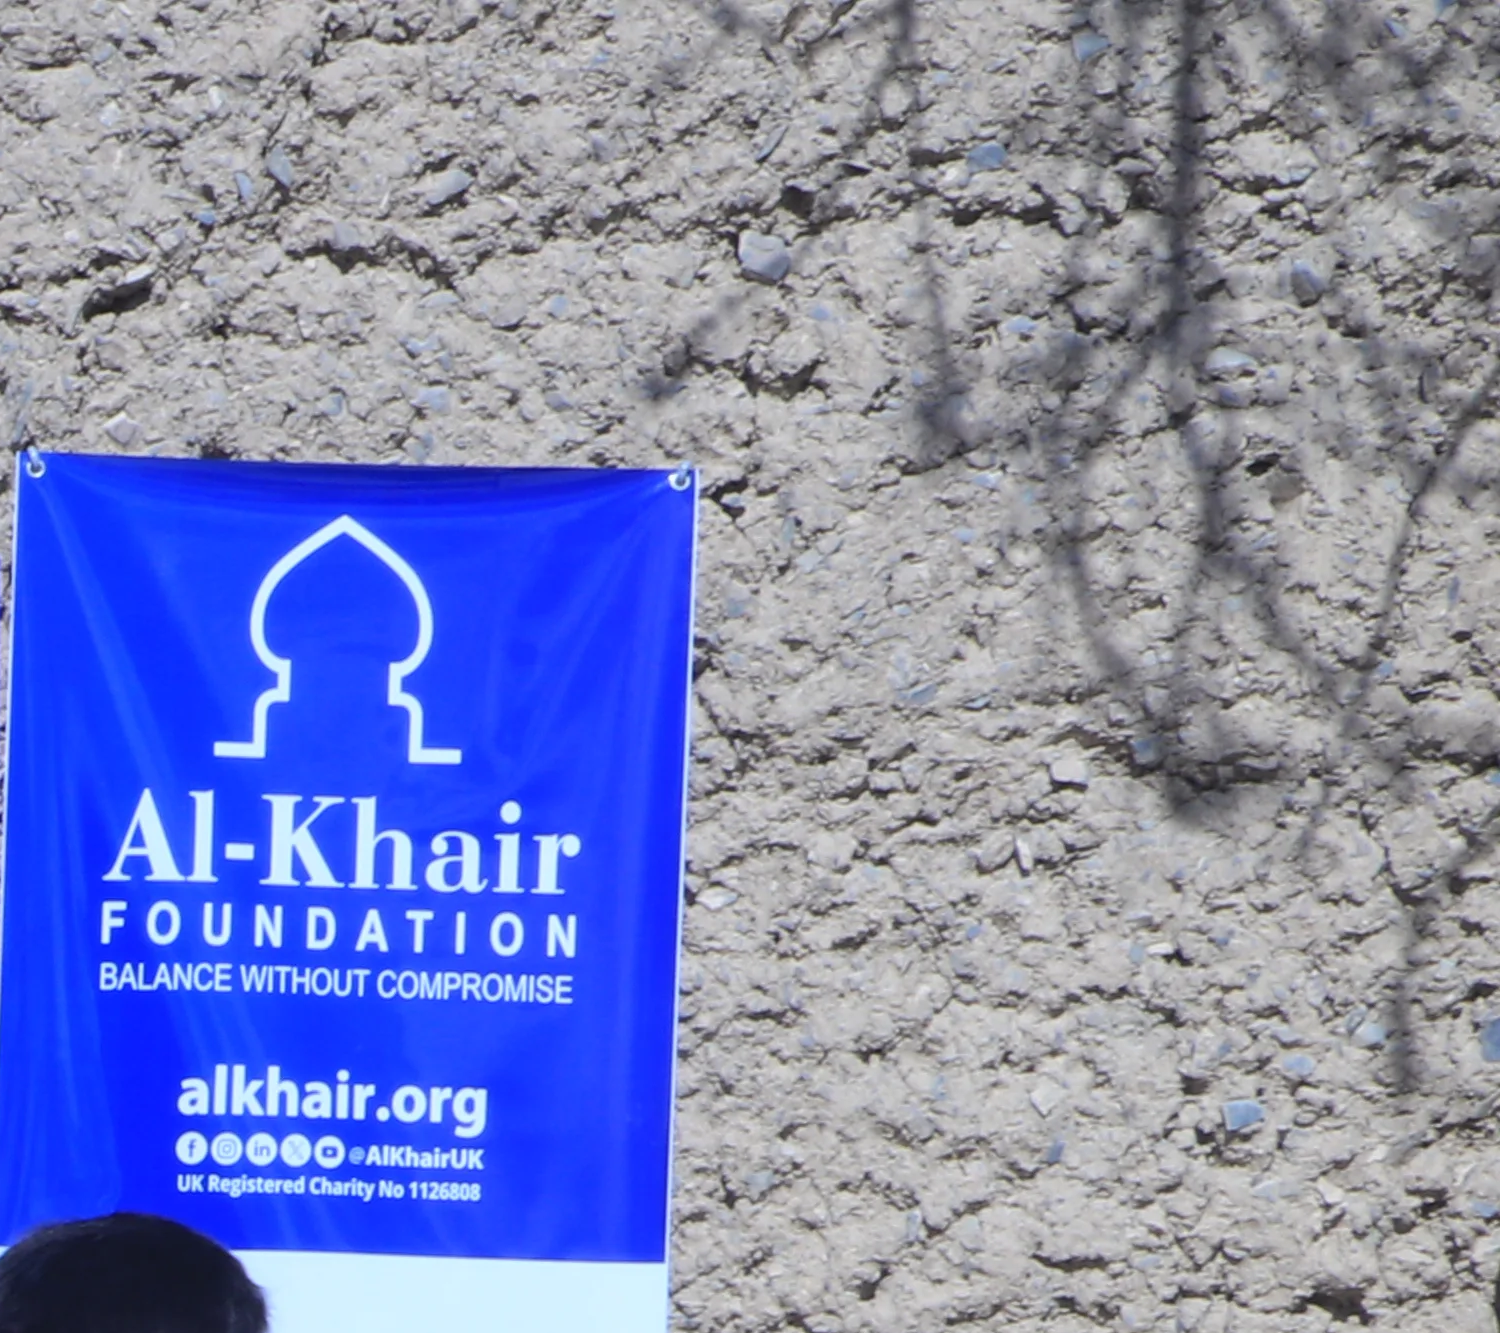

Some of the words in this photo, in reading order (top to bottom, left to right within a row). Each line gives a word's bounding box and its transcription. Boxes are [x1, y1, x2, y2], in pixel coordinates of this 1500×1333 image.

[101, 787, 581, 894] Al-Khair
[101, 901, 576, 958] FOUNDATION
[99, 962, 232, 991] BALANCE
[241, 965, 370, 996] WITHOUT
[377, 970, 572, 1004] COMPROMISE
[177, 1064, 487, 1138] alkhair.org
[349, 1144, 484, 1170] @AlKhairUK
[177, 1174, 204, 1192] UK
[208, 1174, 305, 1198] Registered
[310, 1176, 375, 1201] Charity
[379, 1180, 404, 1198] No
[409, 1182, 481, 1200] 1126808
